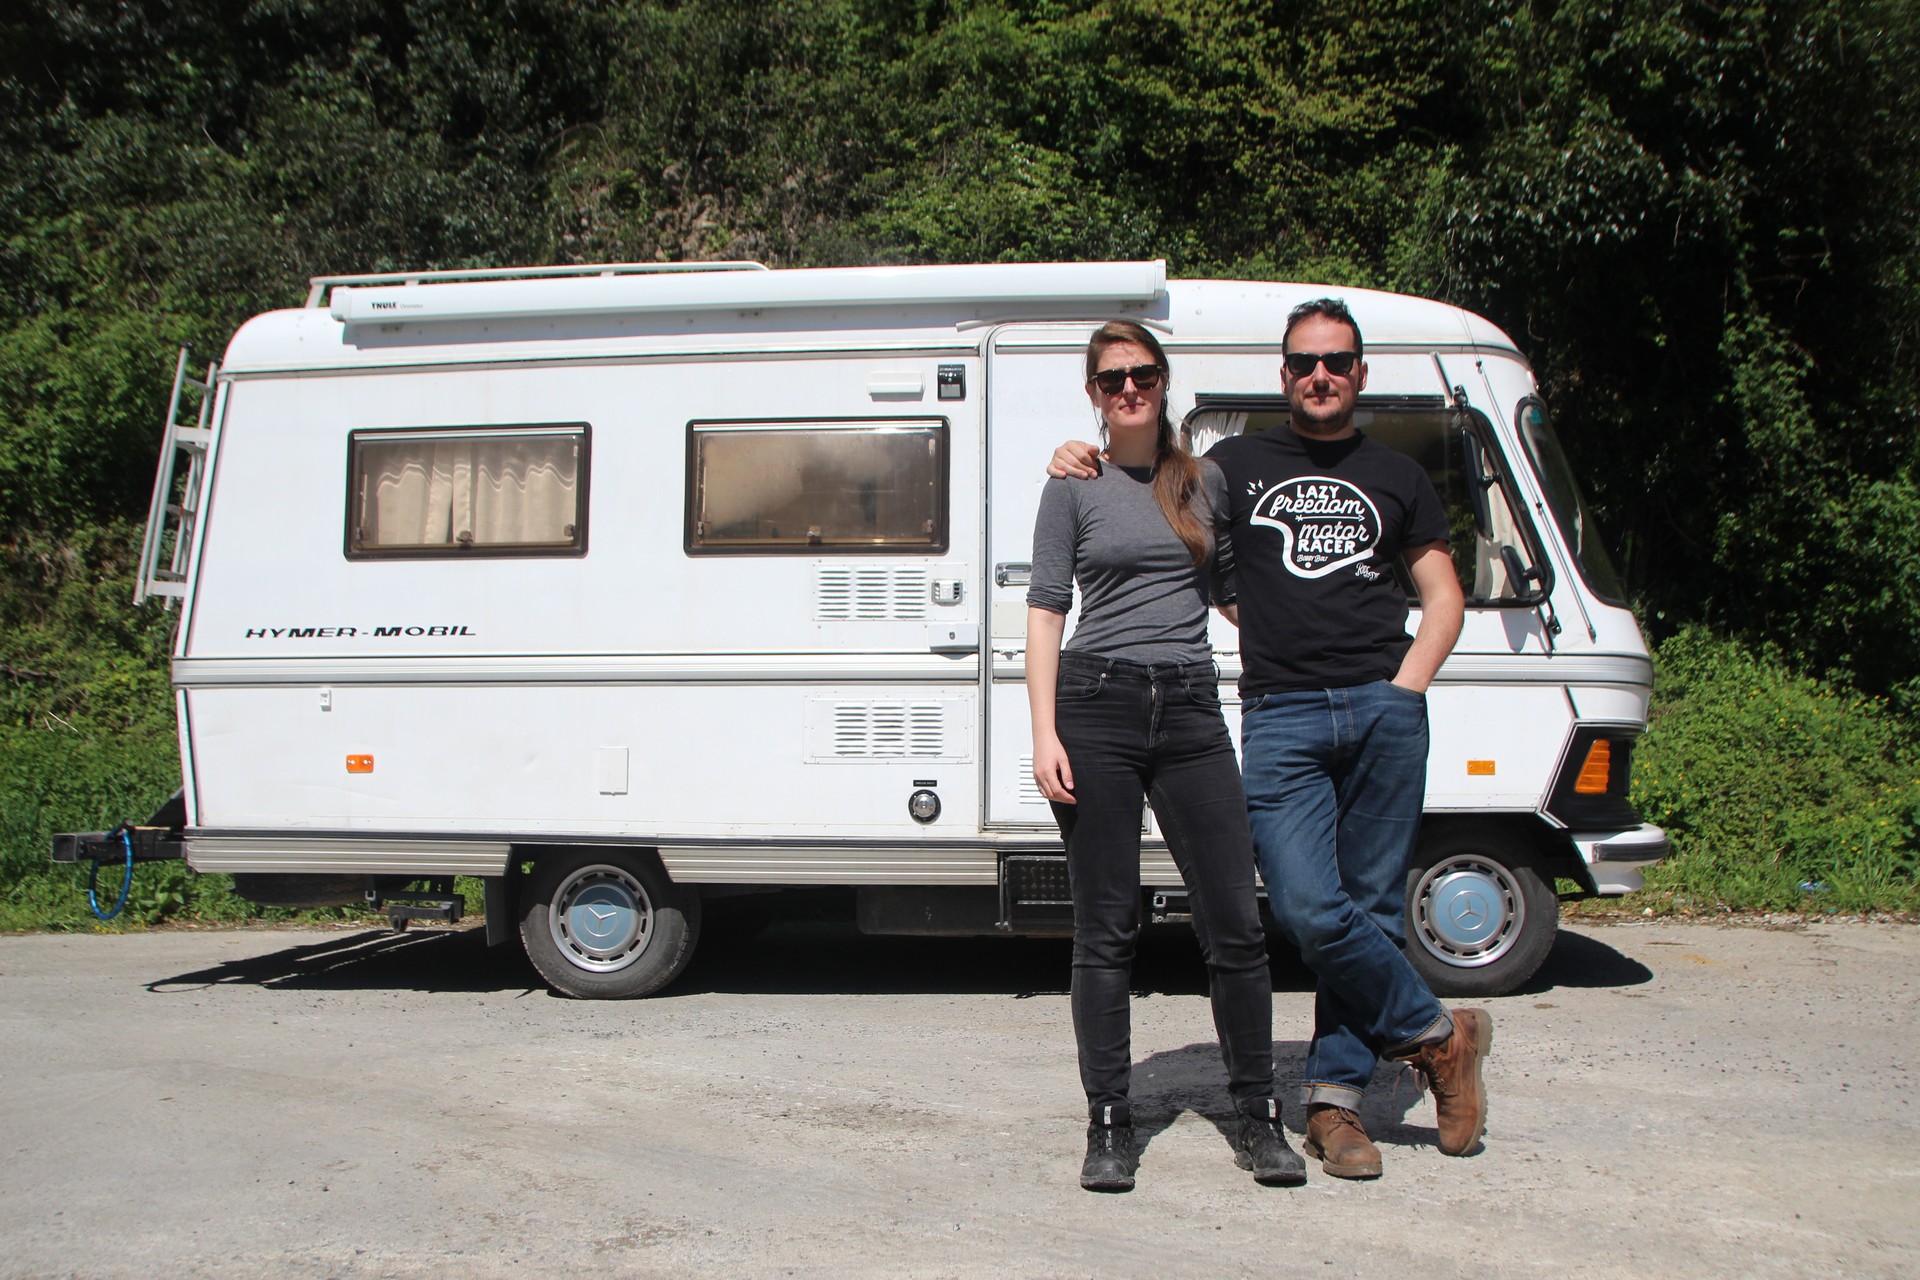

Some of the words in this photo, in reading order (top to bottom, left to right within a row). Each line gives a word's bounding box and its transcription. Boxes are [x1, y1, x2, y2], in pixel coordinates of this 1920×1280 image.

[1296, 484, 1340, 499] LAZY
[1269, 494, 1365, 517] freedom
[1298, 521, 1369, 542] motor
[1297, 539, 1355, 554] RACER
[245, 626, 477, 638] HYMER-MOBIL
